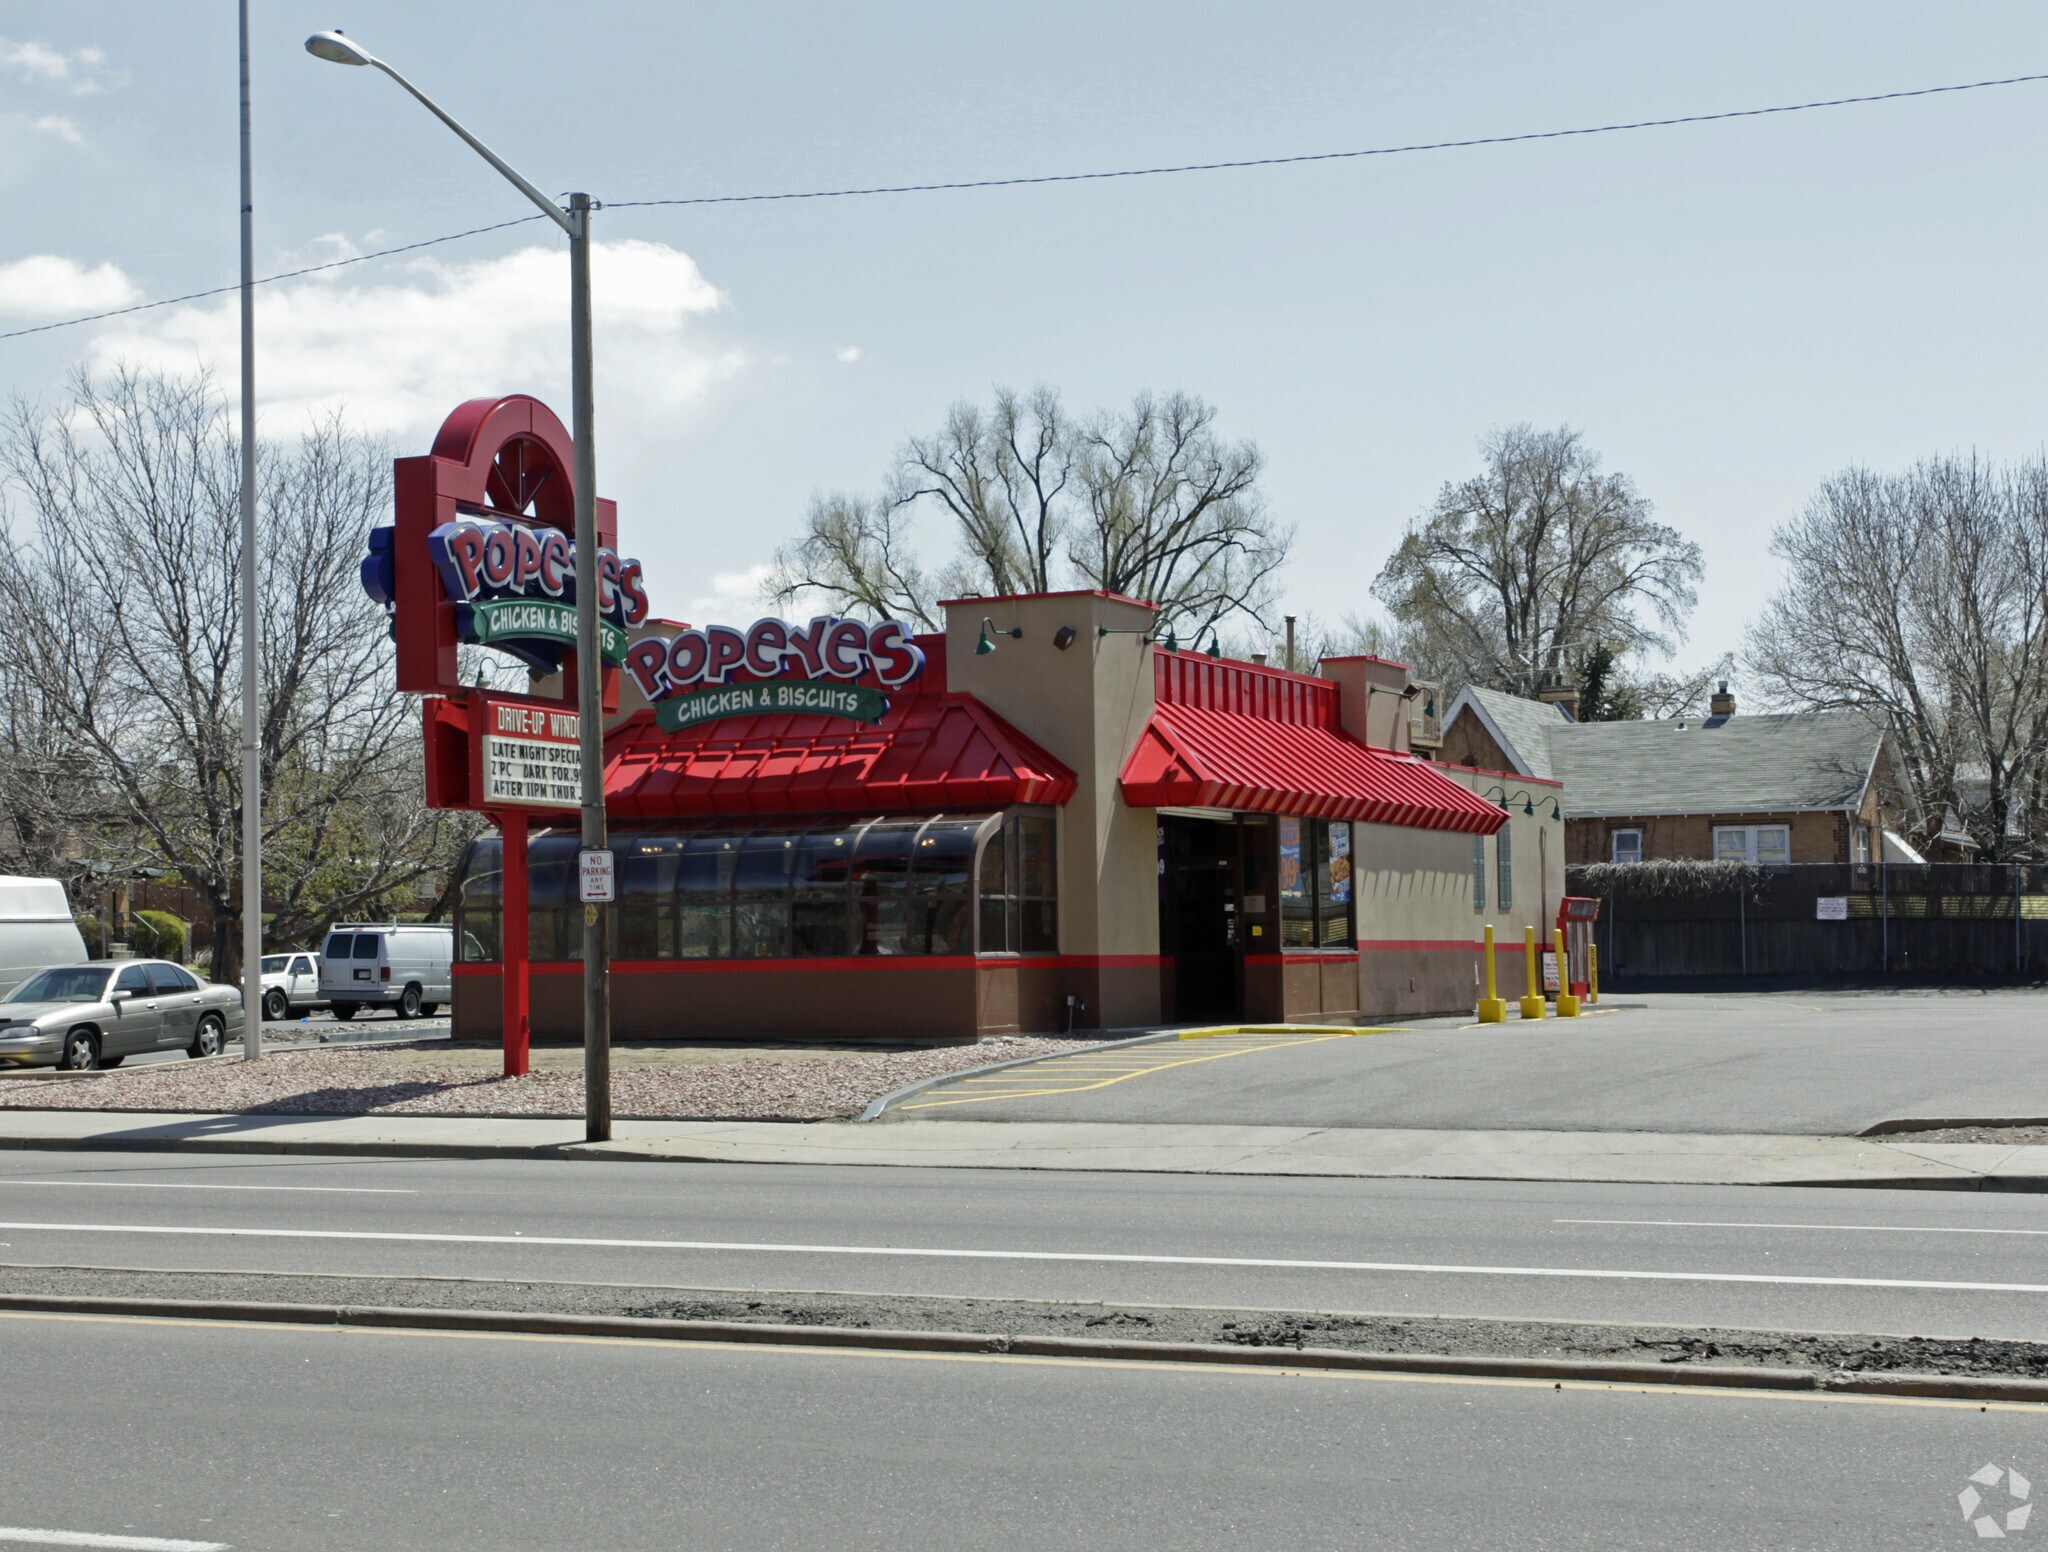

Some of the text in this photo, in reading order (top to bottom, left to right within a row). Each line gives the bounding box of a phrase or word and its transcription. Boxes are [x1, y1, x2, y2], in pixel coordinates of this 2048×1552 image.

[446, 524, 648, 627] POPEES
[490, 606, 615, 651] CHICKEN & BISTS
[678, 686, 858, 722] CHICKEN & BISCUITS
[497, 706, 545, 735] DRIVE-UP
[492, 742, 516, 759] LATE
[519, 744, 546, 761] NIGHT
[491, 760, 496, 775] 2
[500, 762, 511, 777] PC
[523, 764, 547, 780] DARK
[493, 780, 523, 797] AFTER
[527, 782, 547, 798] 11PM
[590, 856, 603, 865] NO
[582, 867, 611, 876] PARKING
